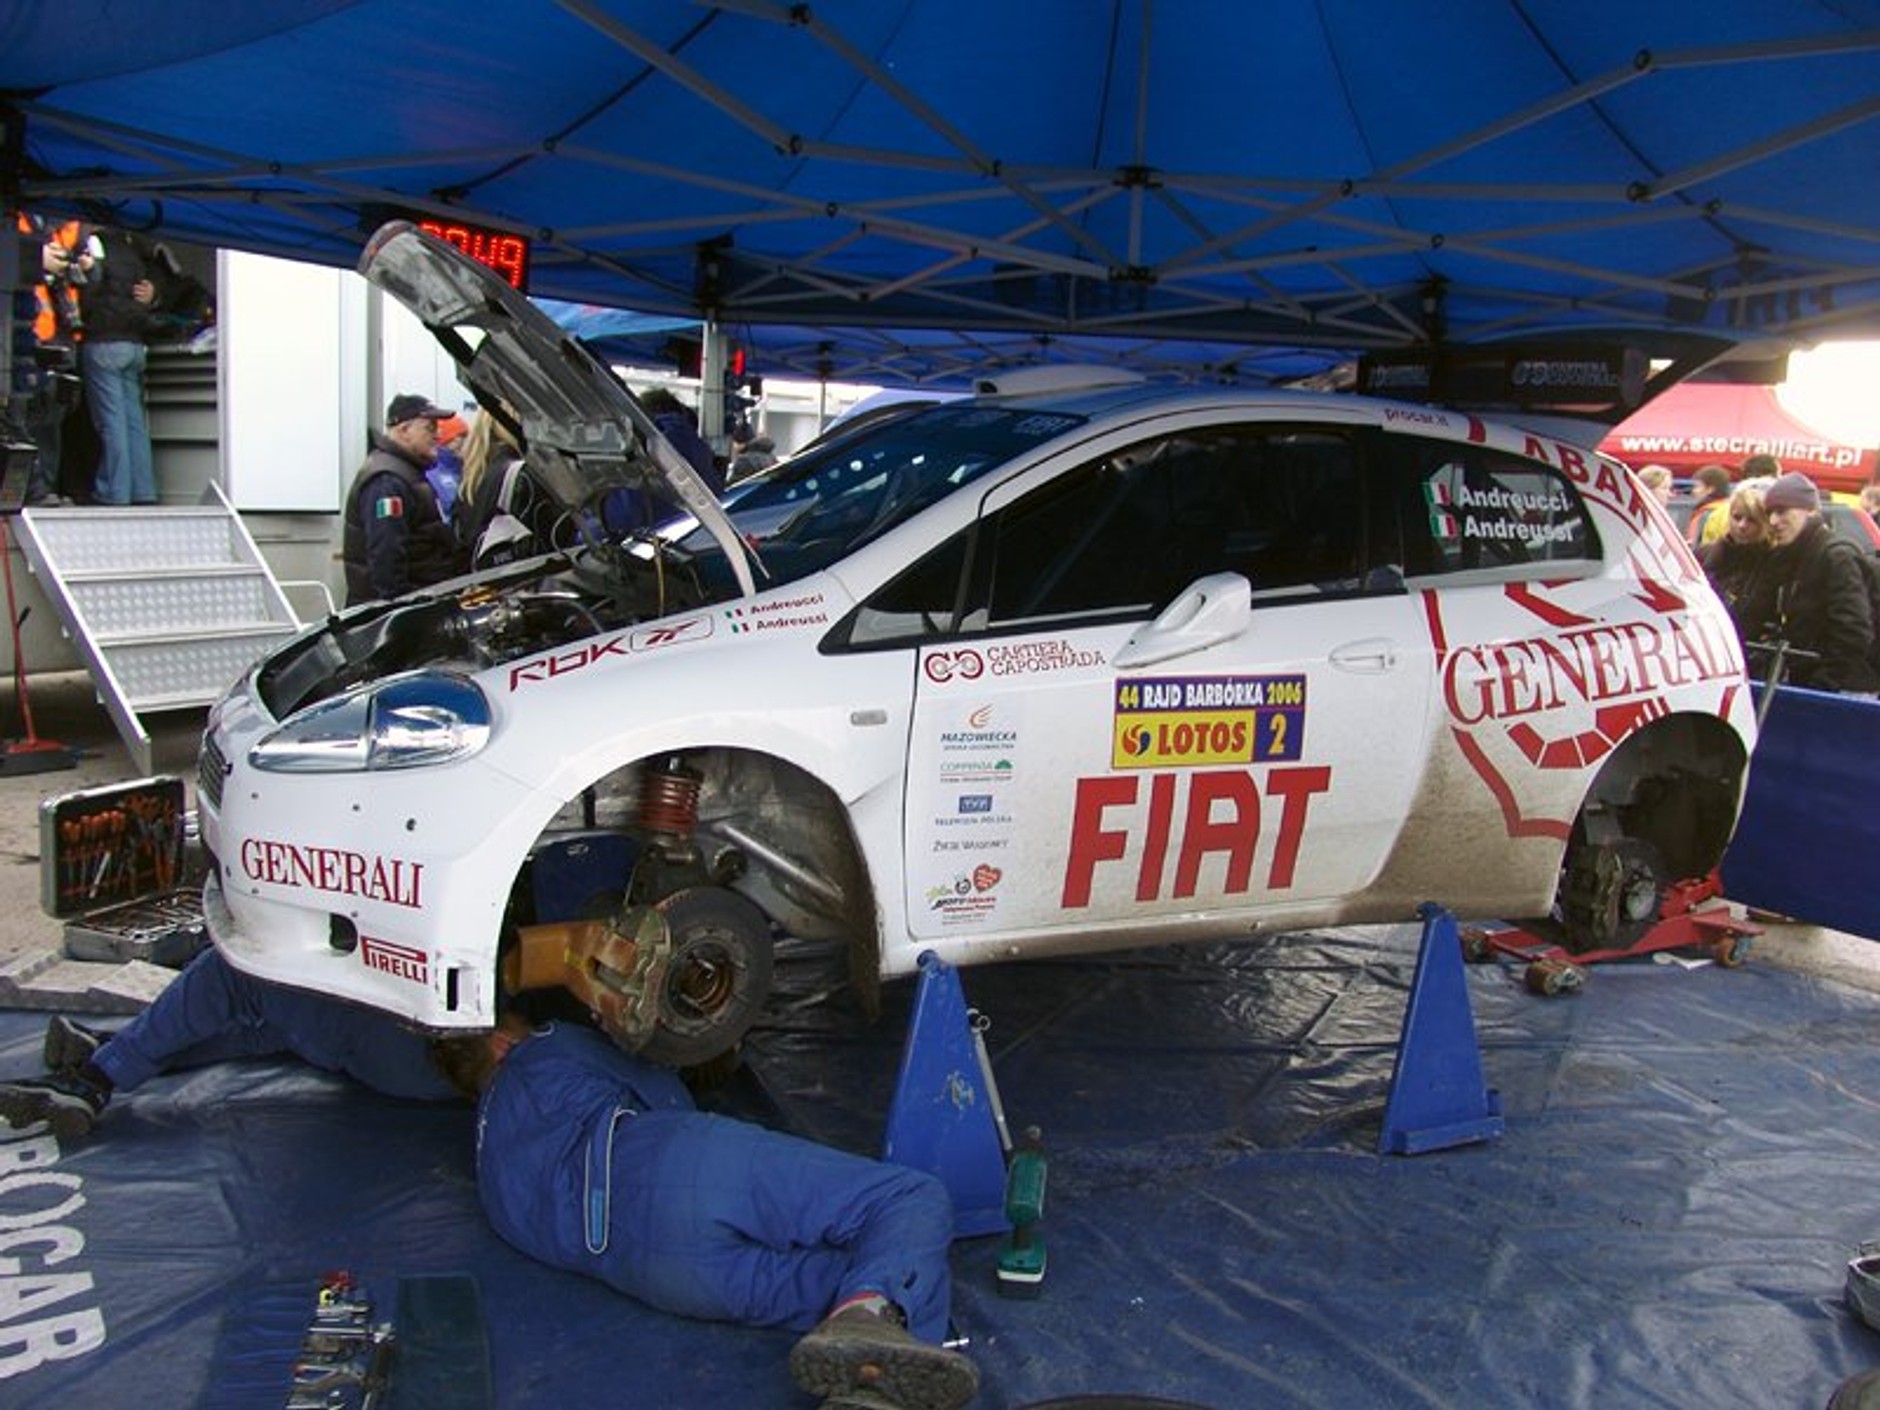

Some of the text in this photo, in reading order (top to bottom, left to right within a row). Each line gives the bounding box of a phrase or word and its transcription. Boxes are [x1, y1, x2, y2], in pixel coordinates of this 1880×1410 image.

[1457, 485, 1570, 511] Andreucci
[987, 639, 1073, 662] CARTIERA
[1442, 613, 1742, 725] GENERALI
[1119, 677, 1302, 708] 44 RAJD BARBÓRKA 2006
[1157, 713, 1288, 756] LOTOS 2
[1061, 766, 1332, 908] FIAT
[241, 838, 424, 909] GENERALI
[361, 935, 428, 985] PIRELLI
